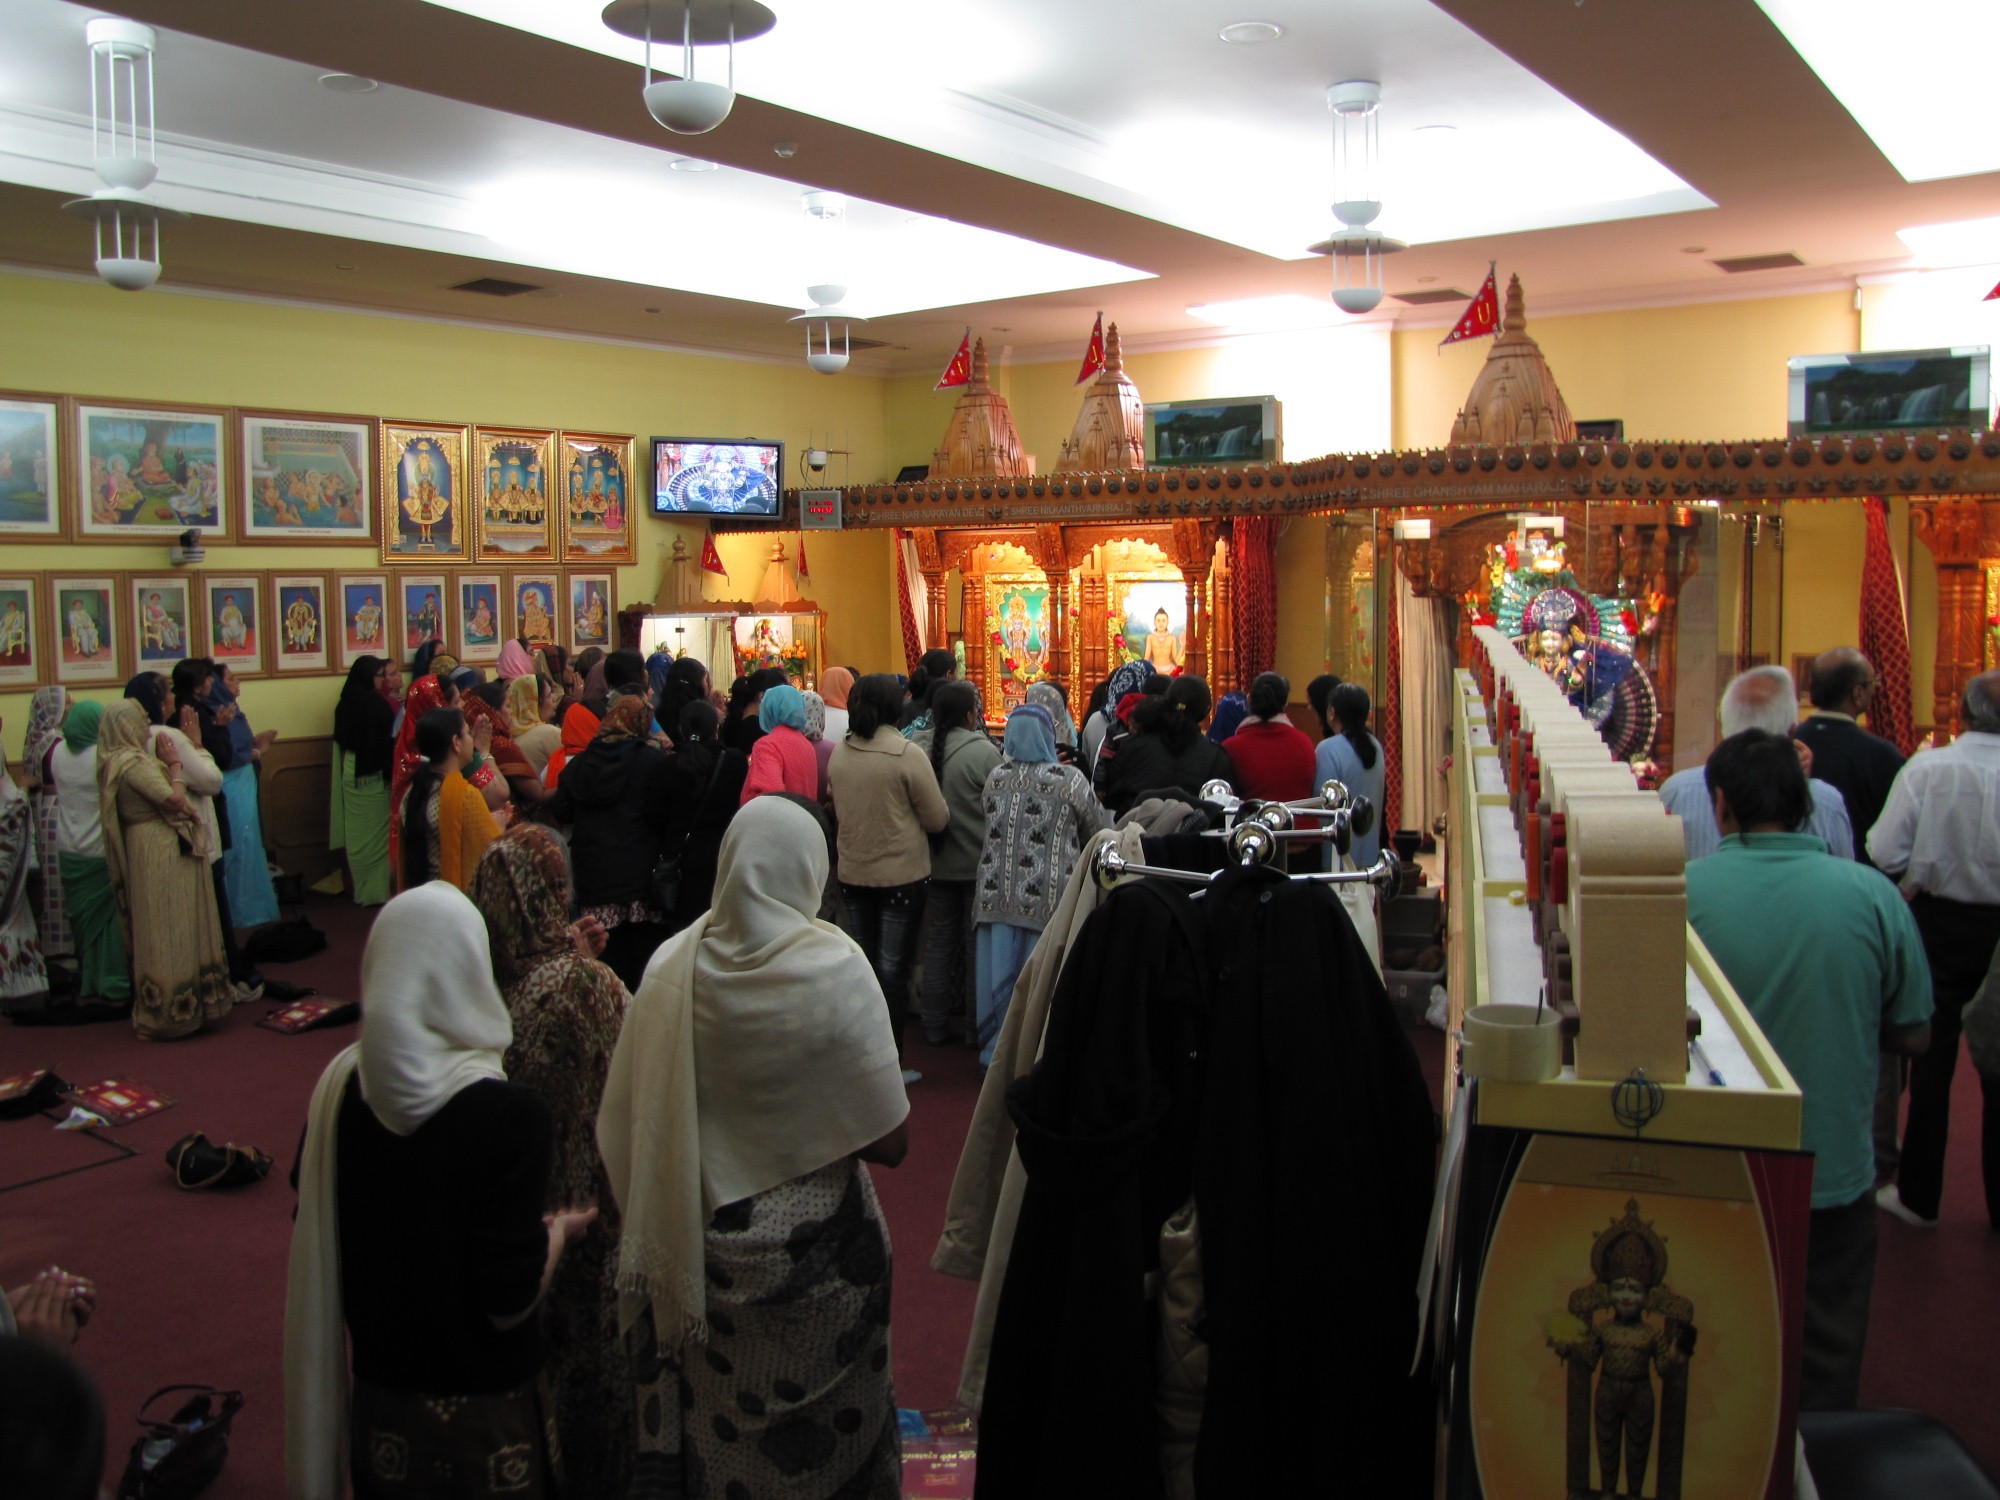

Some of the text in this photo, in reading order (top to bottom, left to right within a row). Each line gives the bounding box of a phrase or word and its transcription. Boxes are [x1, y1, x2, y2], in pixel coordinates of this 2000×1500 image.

[1369, 480, 1560, 499] SHREE GHANSHYAM MAHARAJ
[874, 510, 900, 520] SHREE
[963, 507, 981, 518] DEV
[1010, 502, 1124, 516] SHREE NILKANTHVARNIRAJ
